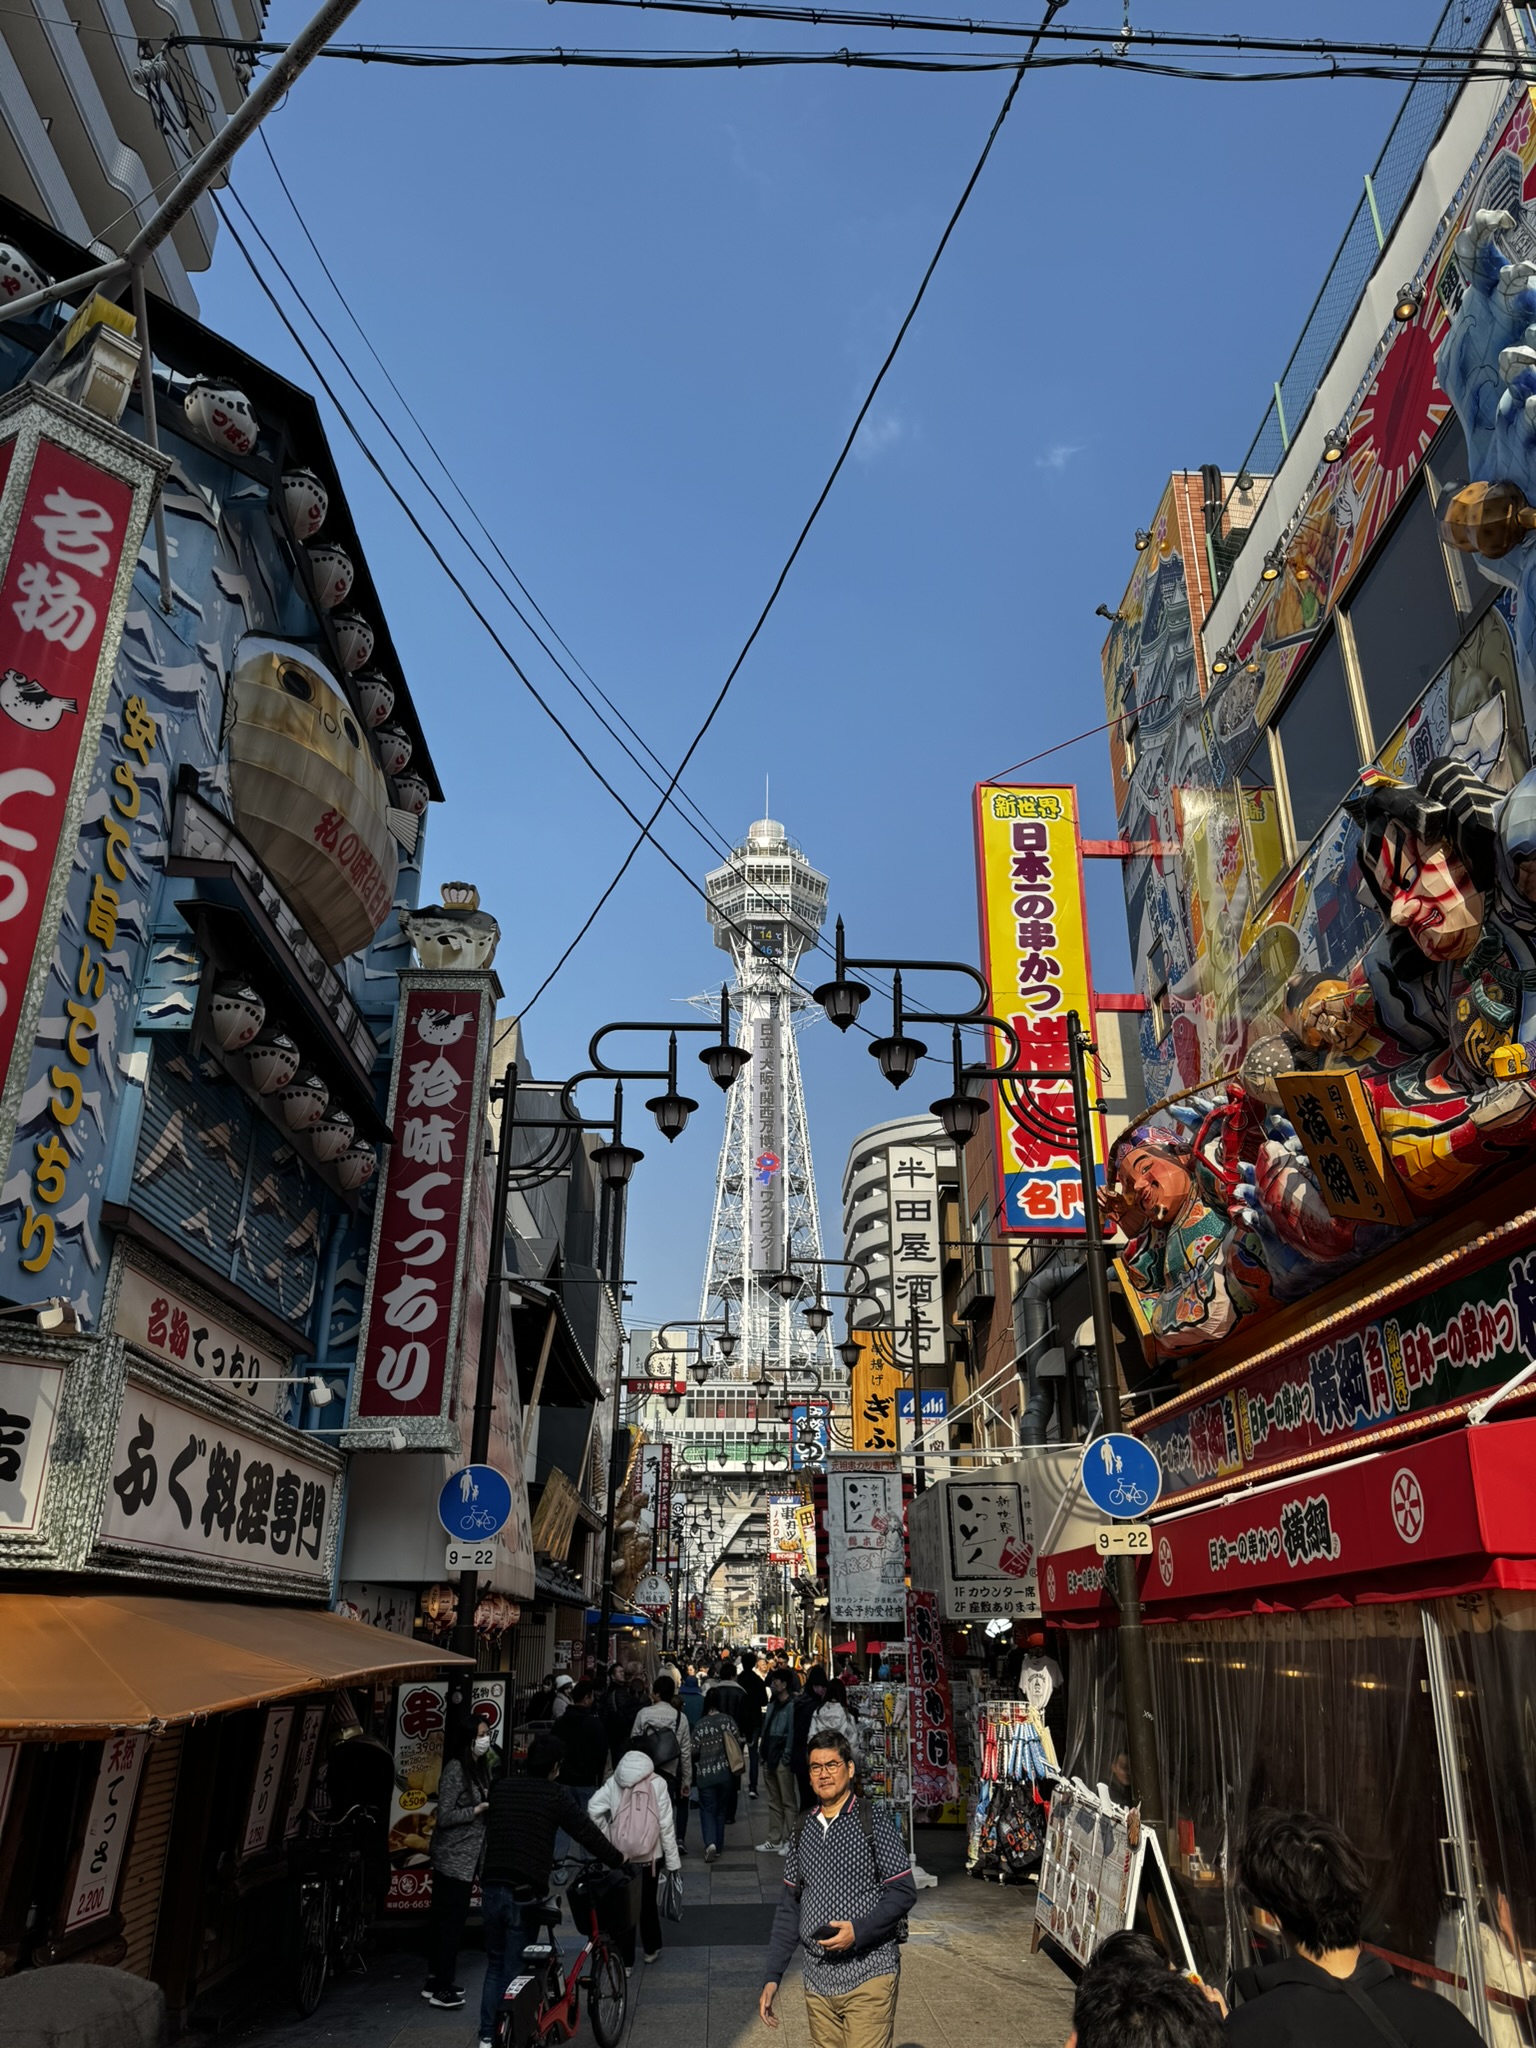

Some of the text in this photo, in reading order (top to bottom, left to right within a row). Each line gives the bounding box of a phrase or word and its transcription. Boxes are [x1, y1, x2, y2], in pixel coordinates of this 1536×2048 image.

[12, 486, 114, 653] 名物
[992, 793, 1064, 820] 新世界
[759, 930, 773, 939] 14
[1009, 821, 1062, 1013] 日本一の串かつ
[1327, 1085, 1386, 1218] 日本一の串かつ
[376, 1056, 464, 1402] 珍味てっちり
[1020, 1179, 1087, 1222] 名門
[892, 1156, 941, 1352] 半田屋酒店
[1309, 1332, 1373, 1436] 横綱
[1364, 1326, 1393, 1418] 名門
[1384, 1318, 1411, 1412] 新世界
[1401, 1299, 1516, 1391] 日本一の串かつ
[902, 1396, 943, 1415] Aahi
[1248, 1381, 1313, 1446] 日本一の串かつ
[113, 1412, 327, 1561] ふぐ料理専門
[1209, 1493, 1334, 1572] 日本一の串かつ 横綱
[954, 1586, 1036, 1598] 1F カウンター席
[954, 1601, 1037, 1613] 2F 座敷あります
[107, 1737, 138, 1773] 天然
[258, 1716, 284, 1815] てっちり
[90, 1775, 125, 1874] てっさ
